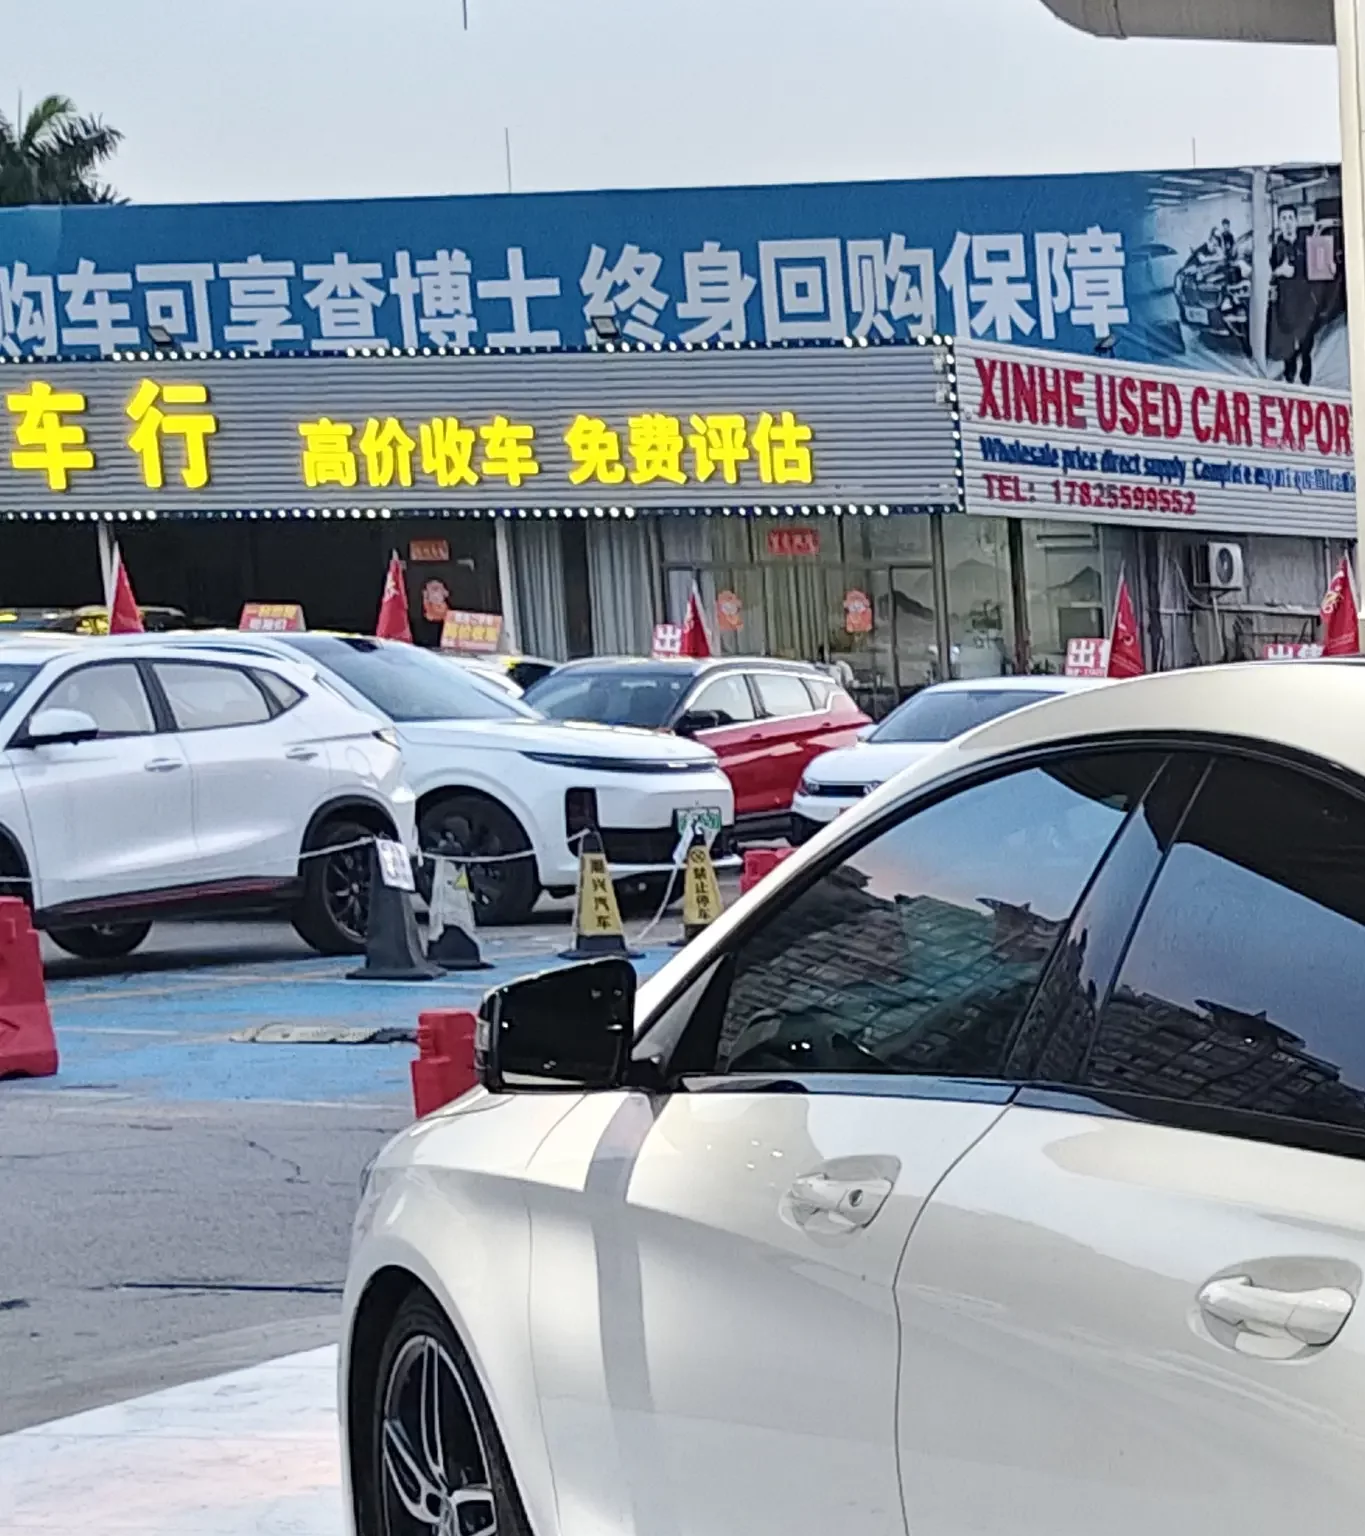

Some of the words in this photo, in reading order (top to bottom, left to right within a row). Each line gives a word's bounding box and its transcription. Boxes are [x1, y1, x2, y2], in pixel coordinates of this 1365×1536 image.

[580, 224, 1129, 344] 终身回购保障
[7, 378, 217, 490] 车行
[299, 415, 539, 487] 高价收车
[564, 411, 813, 486] 免费评估
[975, 357, 1088, 429] XINHE
[1095, 373, 1183, 440] USED
[1192, 386, 1253, 446] CAR
[1260, 395, 1352, 456] EXPOR
[980, 437, 1058, 468] Wholesale
[1062, 445, 1098, 475] price
[1100, 449, 1141, 475] direct
[1144, 454, 1186, 486] supply
[1051, 479, 1197, 515] 17825599552
